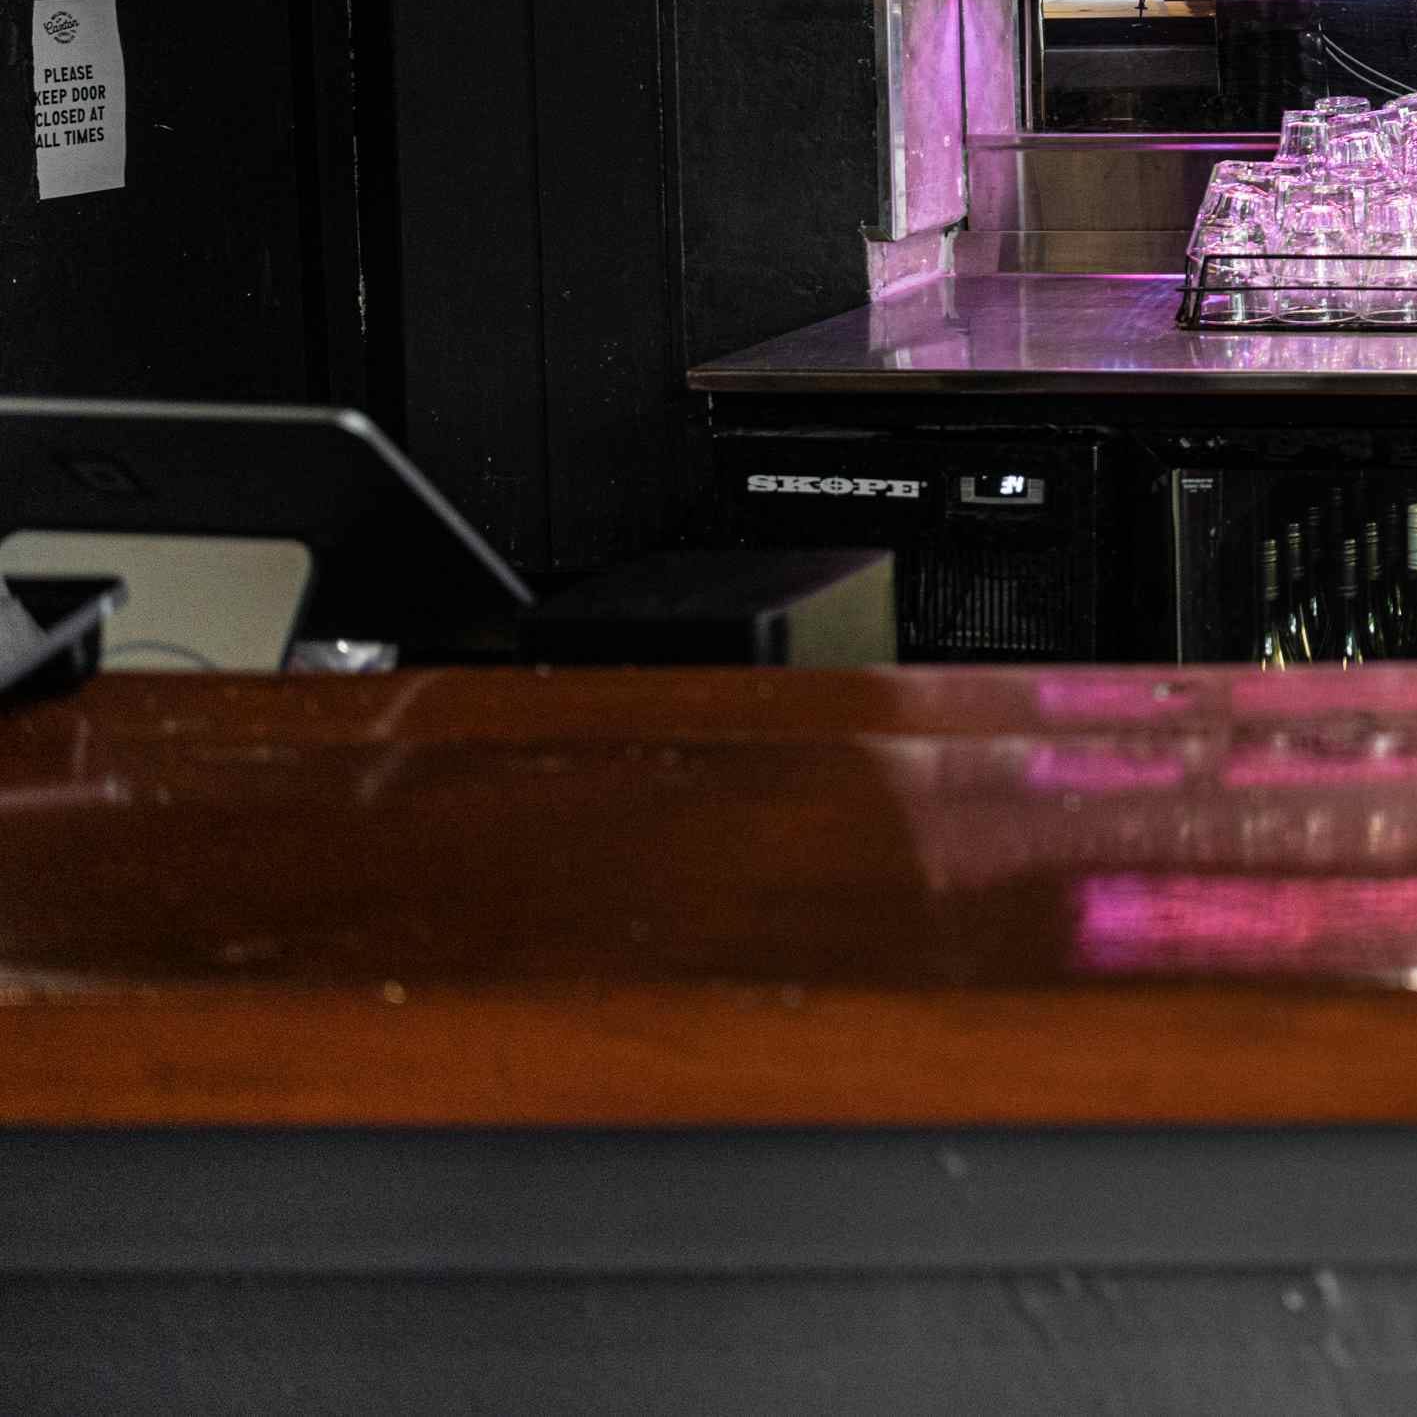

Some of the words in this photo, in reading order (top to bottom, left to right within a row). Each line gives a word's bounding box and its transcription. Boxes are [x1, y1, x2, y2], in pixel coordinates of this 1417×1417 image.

[44, 64, 94, 83] PLEASE
[35, 89, 68, 106] KEEP
[72, 84, 106, 102] DOOR
[35, 107, 86, 127] CLOSED
[90, 105, 105, 122] AT
[35, 132, 60, 149] ALL
[64, 127, 105, 146] TIMES
[747, 474, 920, 497] SKOPE
